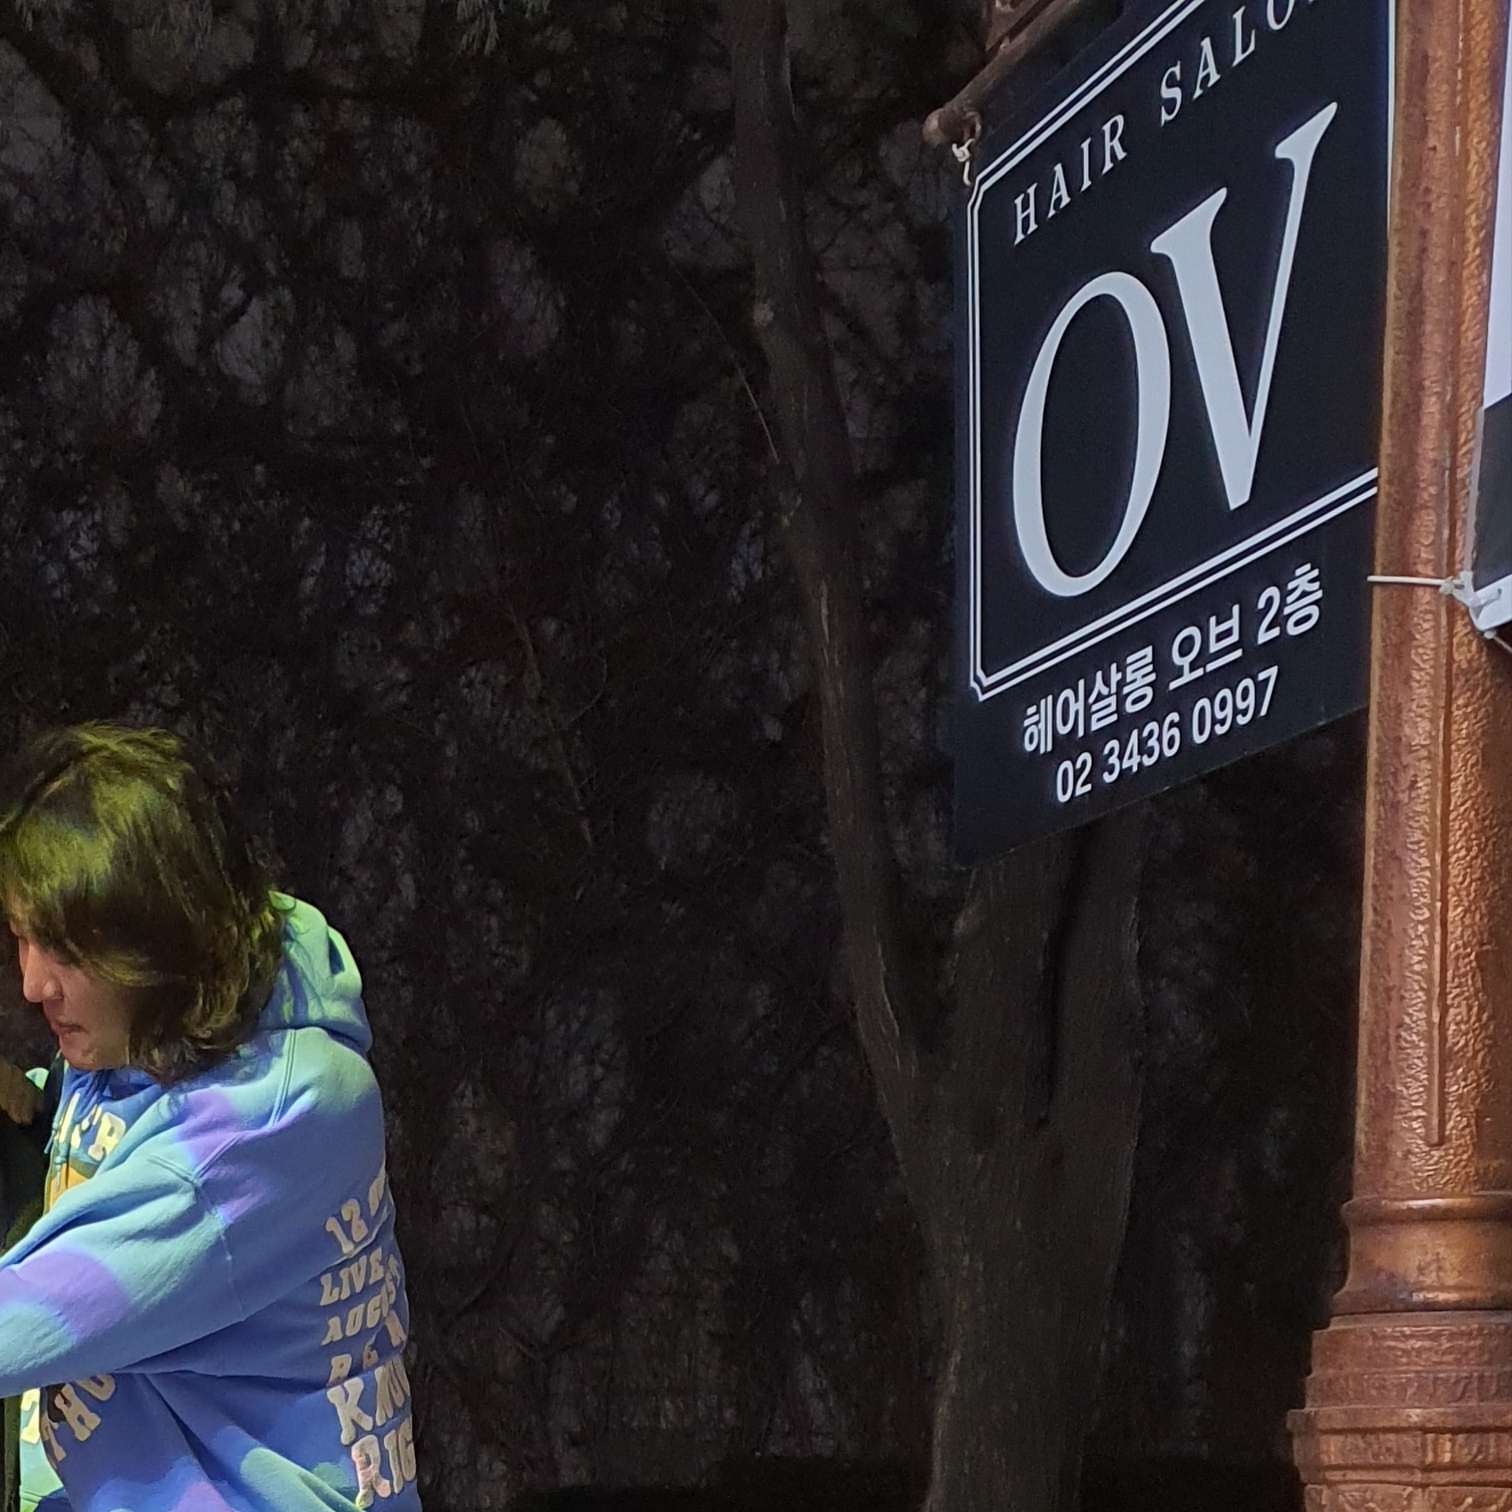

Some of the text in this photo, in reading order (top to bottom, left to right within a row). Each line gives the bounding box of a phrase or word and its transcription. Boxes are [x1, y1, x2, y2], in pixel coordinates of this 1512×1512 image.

[1014, 0, 1314, 246] HAIR SALO
[1012, 102, 1338, 598] OV
[1023, 562, 1323, 754] 헤어살롱 오브 2층
[1056, 665, 1279, 803] 02 3436 0997
[320, 1247, 385, 1307] LIVE
